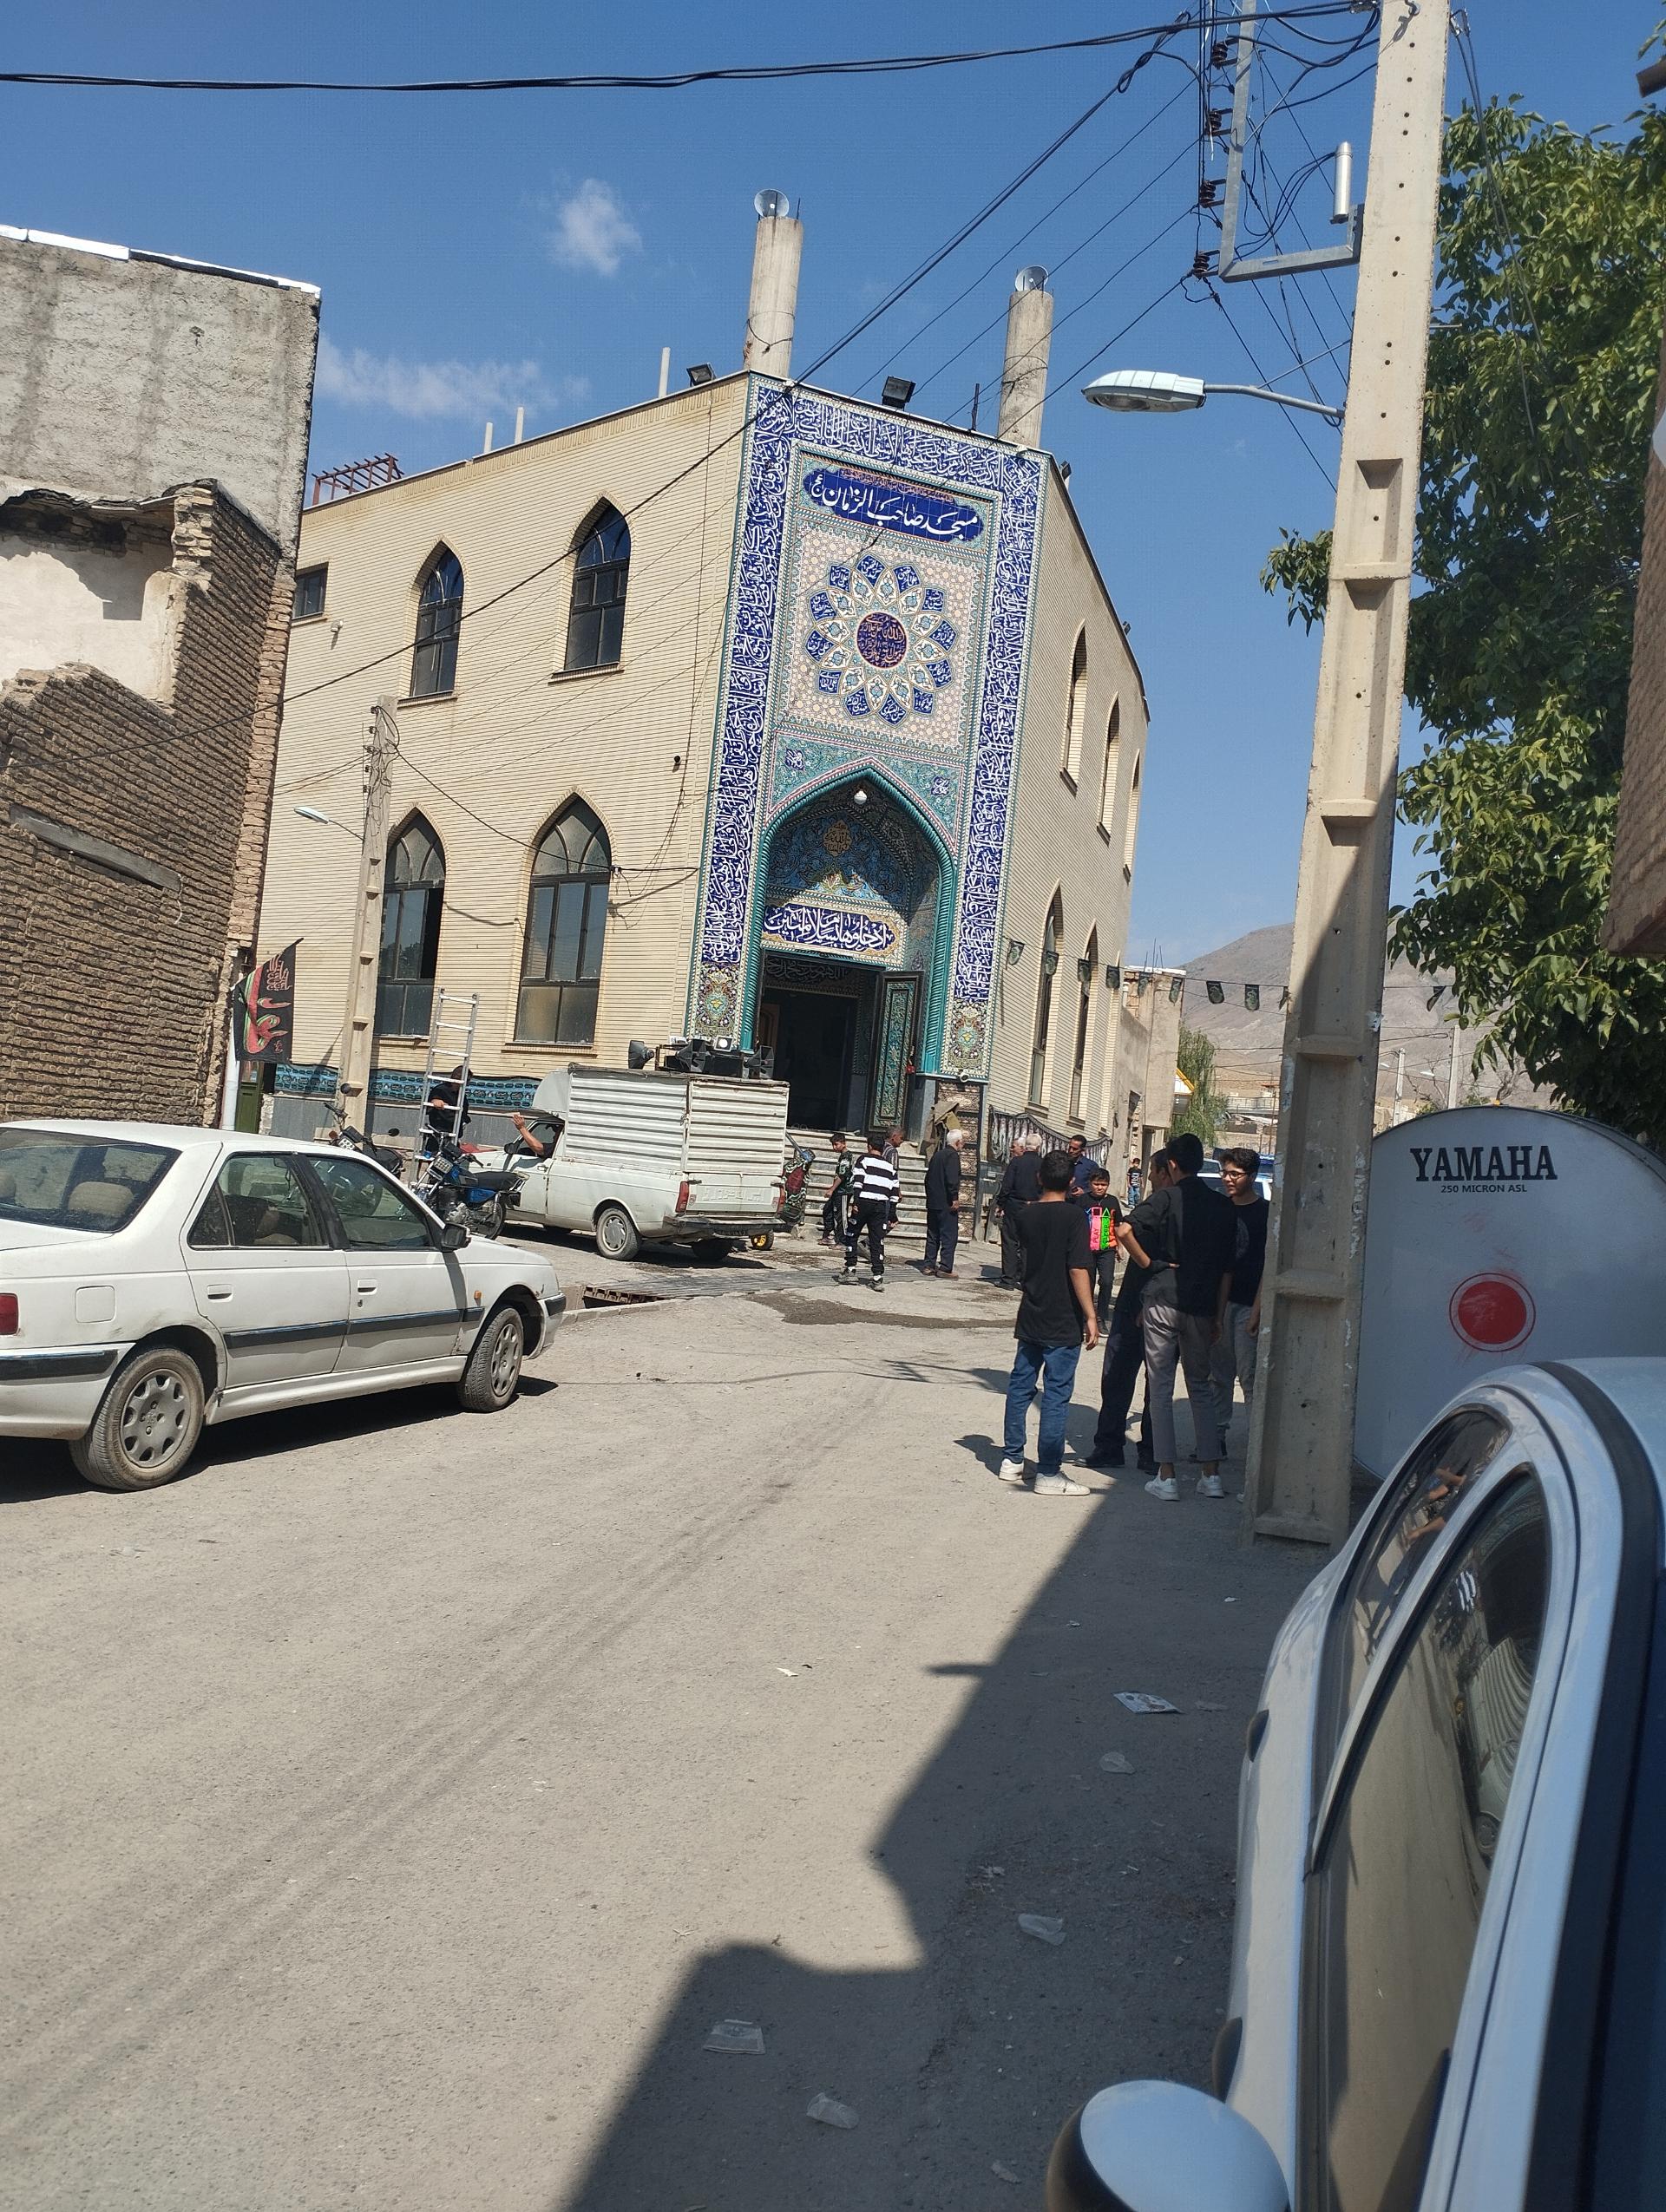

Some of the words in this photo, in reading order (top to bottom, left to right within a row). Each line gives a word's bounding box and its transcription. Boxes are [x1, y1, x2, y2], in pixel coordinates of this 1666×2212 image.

[867, 495, 923, 526] صاحب
[922, 510, 978, 540] مسجد
[1409, 1145, 1558, 1182] YAMAHA
[1440, 1185, 1459, 1194] 250
[1462, 1184, 1505, 1193] MICRON
[1508, 1184, 1528, 1193] ASL
